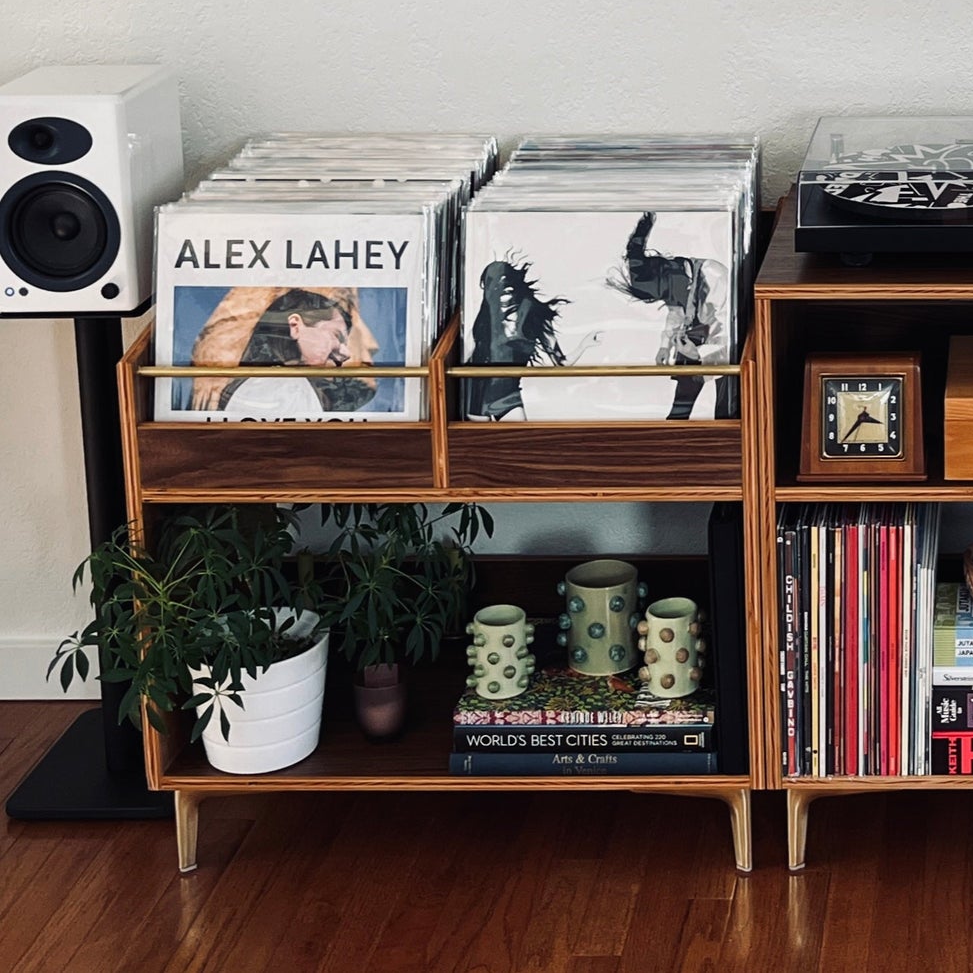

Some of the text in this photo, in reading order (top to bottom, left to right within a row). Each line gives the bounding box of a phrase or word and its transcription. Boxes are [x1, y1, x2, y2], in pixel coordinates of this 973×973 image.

[174, 239, 410, 270] ALEX LAHEY
[841, 383, 848, 391] 11
[858, 383, 867, 391] 12
[827, 397, 837, 405] 10
[890, 396, 897, 404] 2
[828, 414, 835, 422] 9
[890, 413, 897, 421] 3
[828, 432, 835, 440] 8
[889, 431, 897, 439] 4
[842, 444, 849, 452] 7
[859, 444, 866, 452] 6
[878, 444, 884, 452] 5
[785, 575, 794, 652] CHILDISH
[940, 697, 950, 724] Music
[466, 734, 608, 747] WORLD'S BEST CITIES
[552, 753, 618, 765] Arts & Crafts
[948, 737, 957, 774] KEITH
